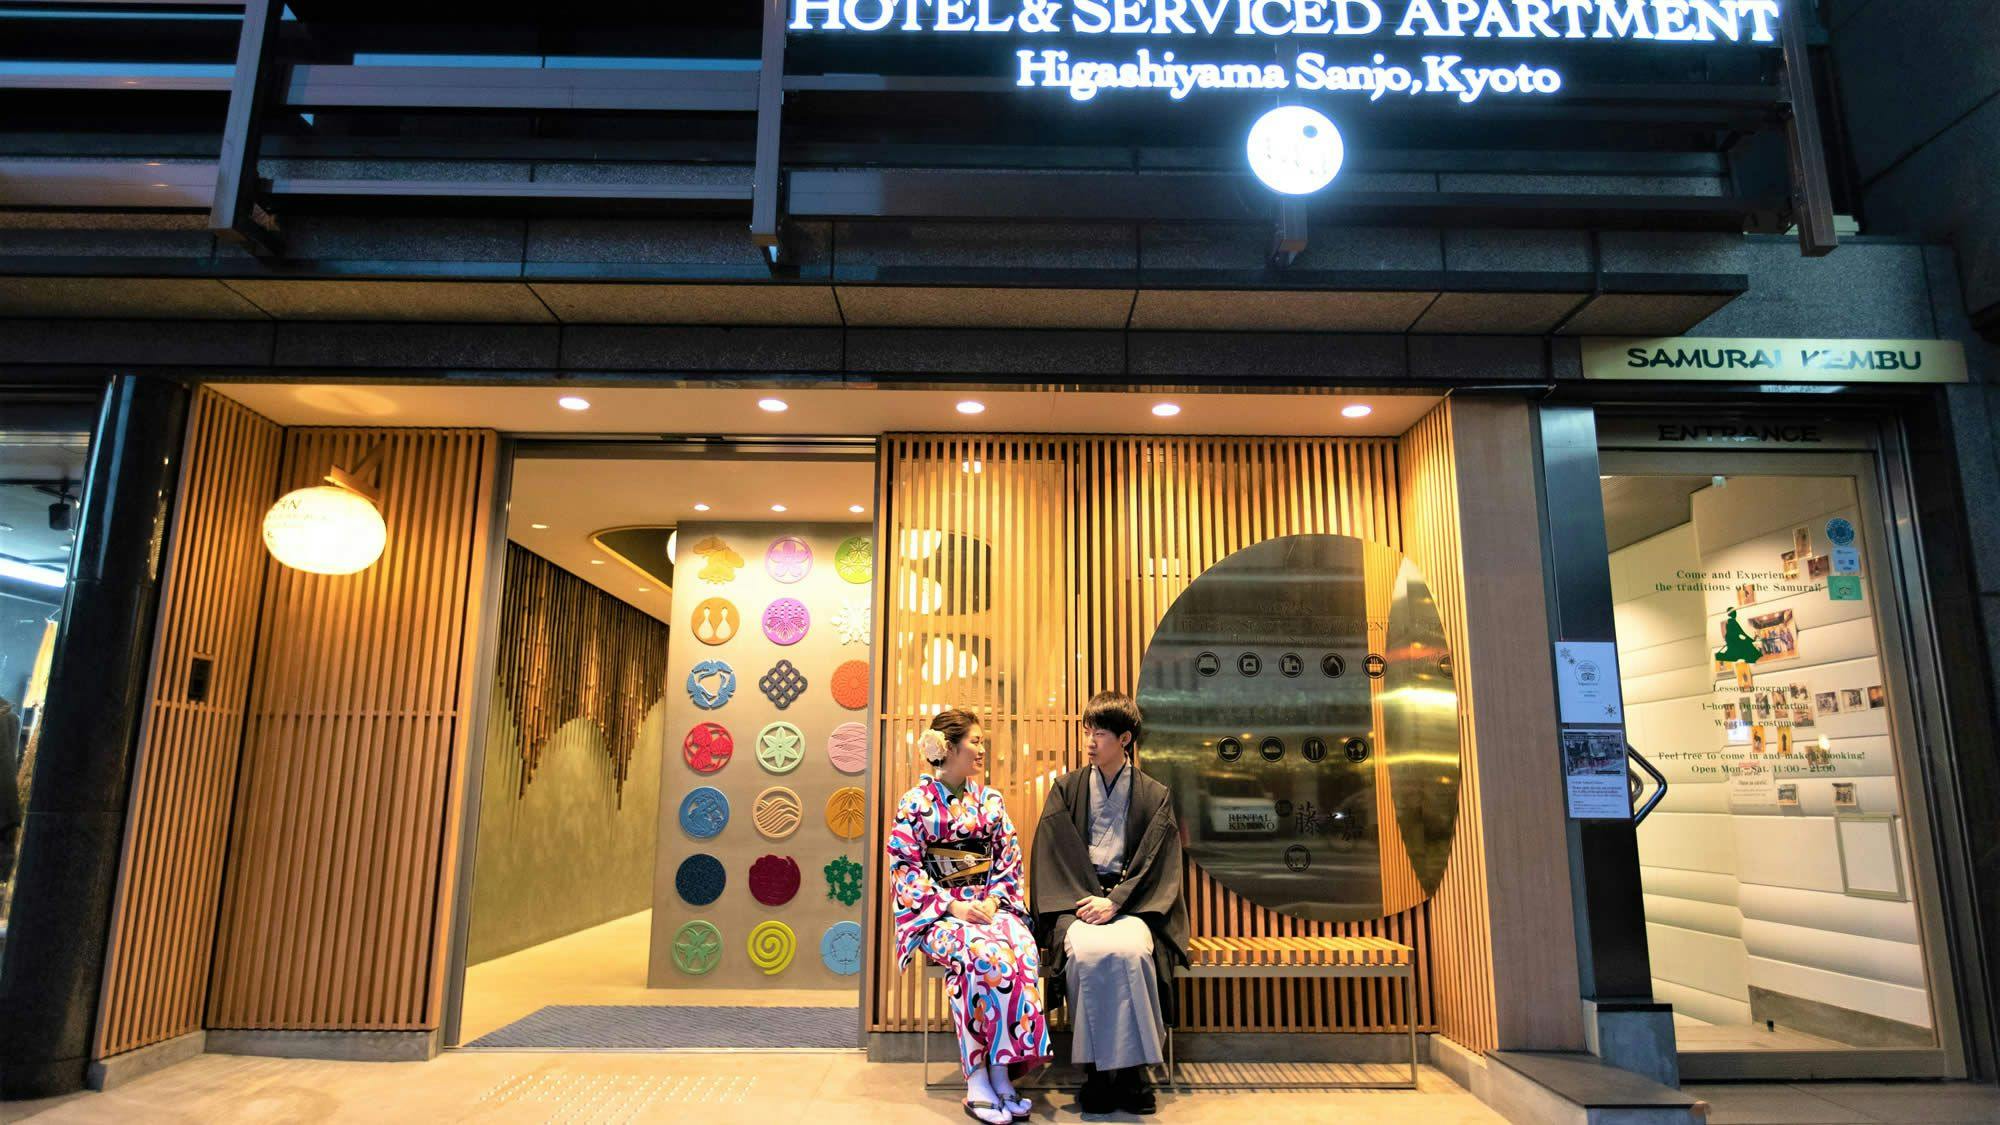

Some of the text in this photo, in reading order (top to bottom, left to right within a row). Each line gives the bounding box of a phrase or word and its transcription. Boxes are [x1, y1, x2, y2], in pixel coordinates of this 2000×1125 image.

[790, 0, 1779, 42] HOTEL & SERVICED APARTMENT
[1016, 49, 1288, 100] Higashiyama
[1627, 348, 1921, 370] SAMURAI KEMBU
[1658, 424, 1821, 442] ENTRANCE
[1676, 570, 1797, 581] Come and Experience
[1655, 583, 1672, 592] the
[1677, 583, 1731, 592] traditions
[1751, 583, 1769, 592] the
[1712, 684, 1745, 692] Lesson
[1658, 752, 1679, 760] Feel
[1683, 752, 1703, 760] free
[1707, 752, 1717, 760] to
[1749, 752, 1759, 760] in
[1762, 752, 1780, 760] and
[1785, 752, 1808, 760] make
[1691, 765, 1718, 774] Open
[1229, 814, 1271, 822] RENTAL
[1229, 822, 1275, 831] KIMONO
